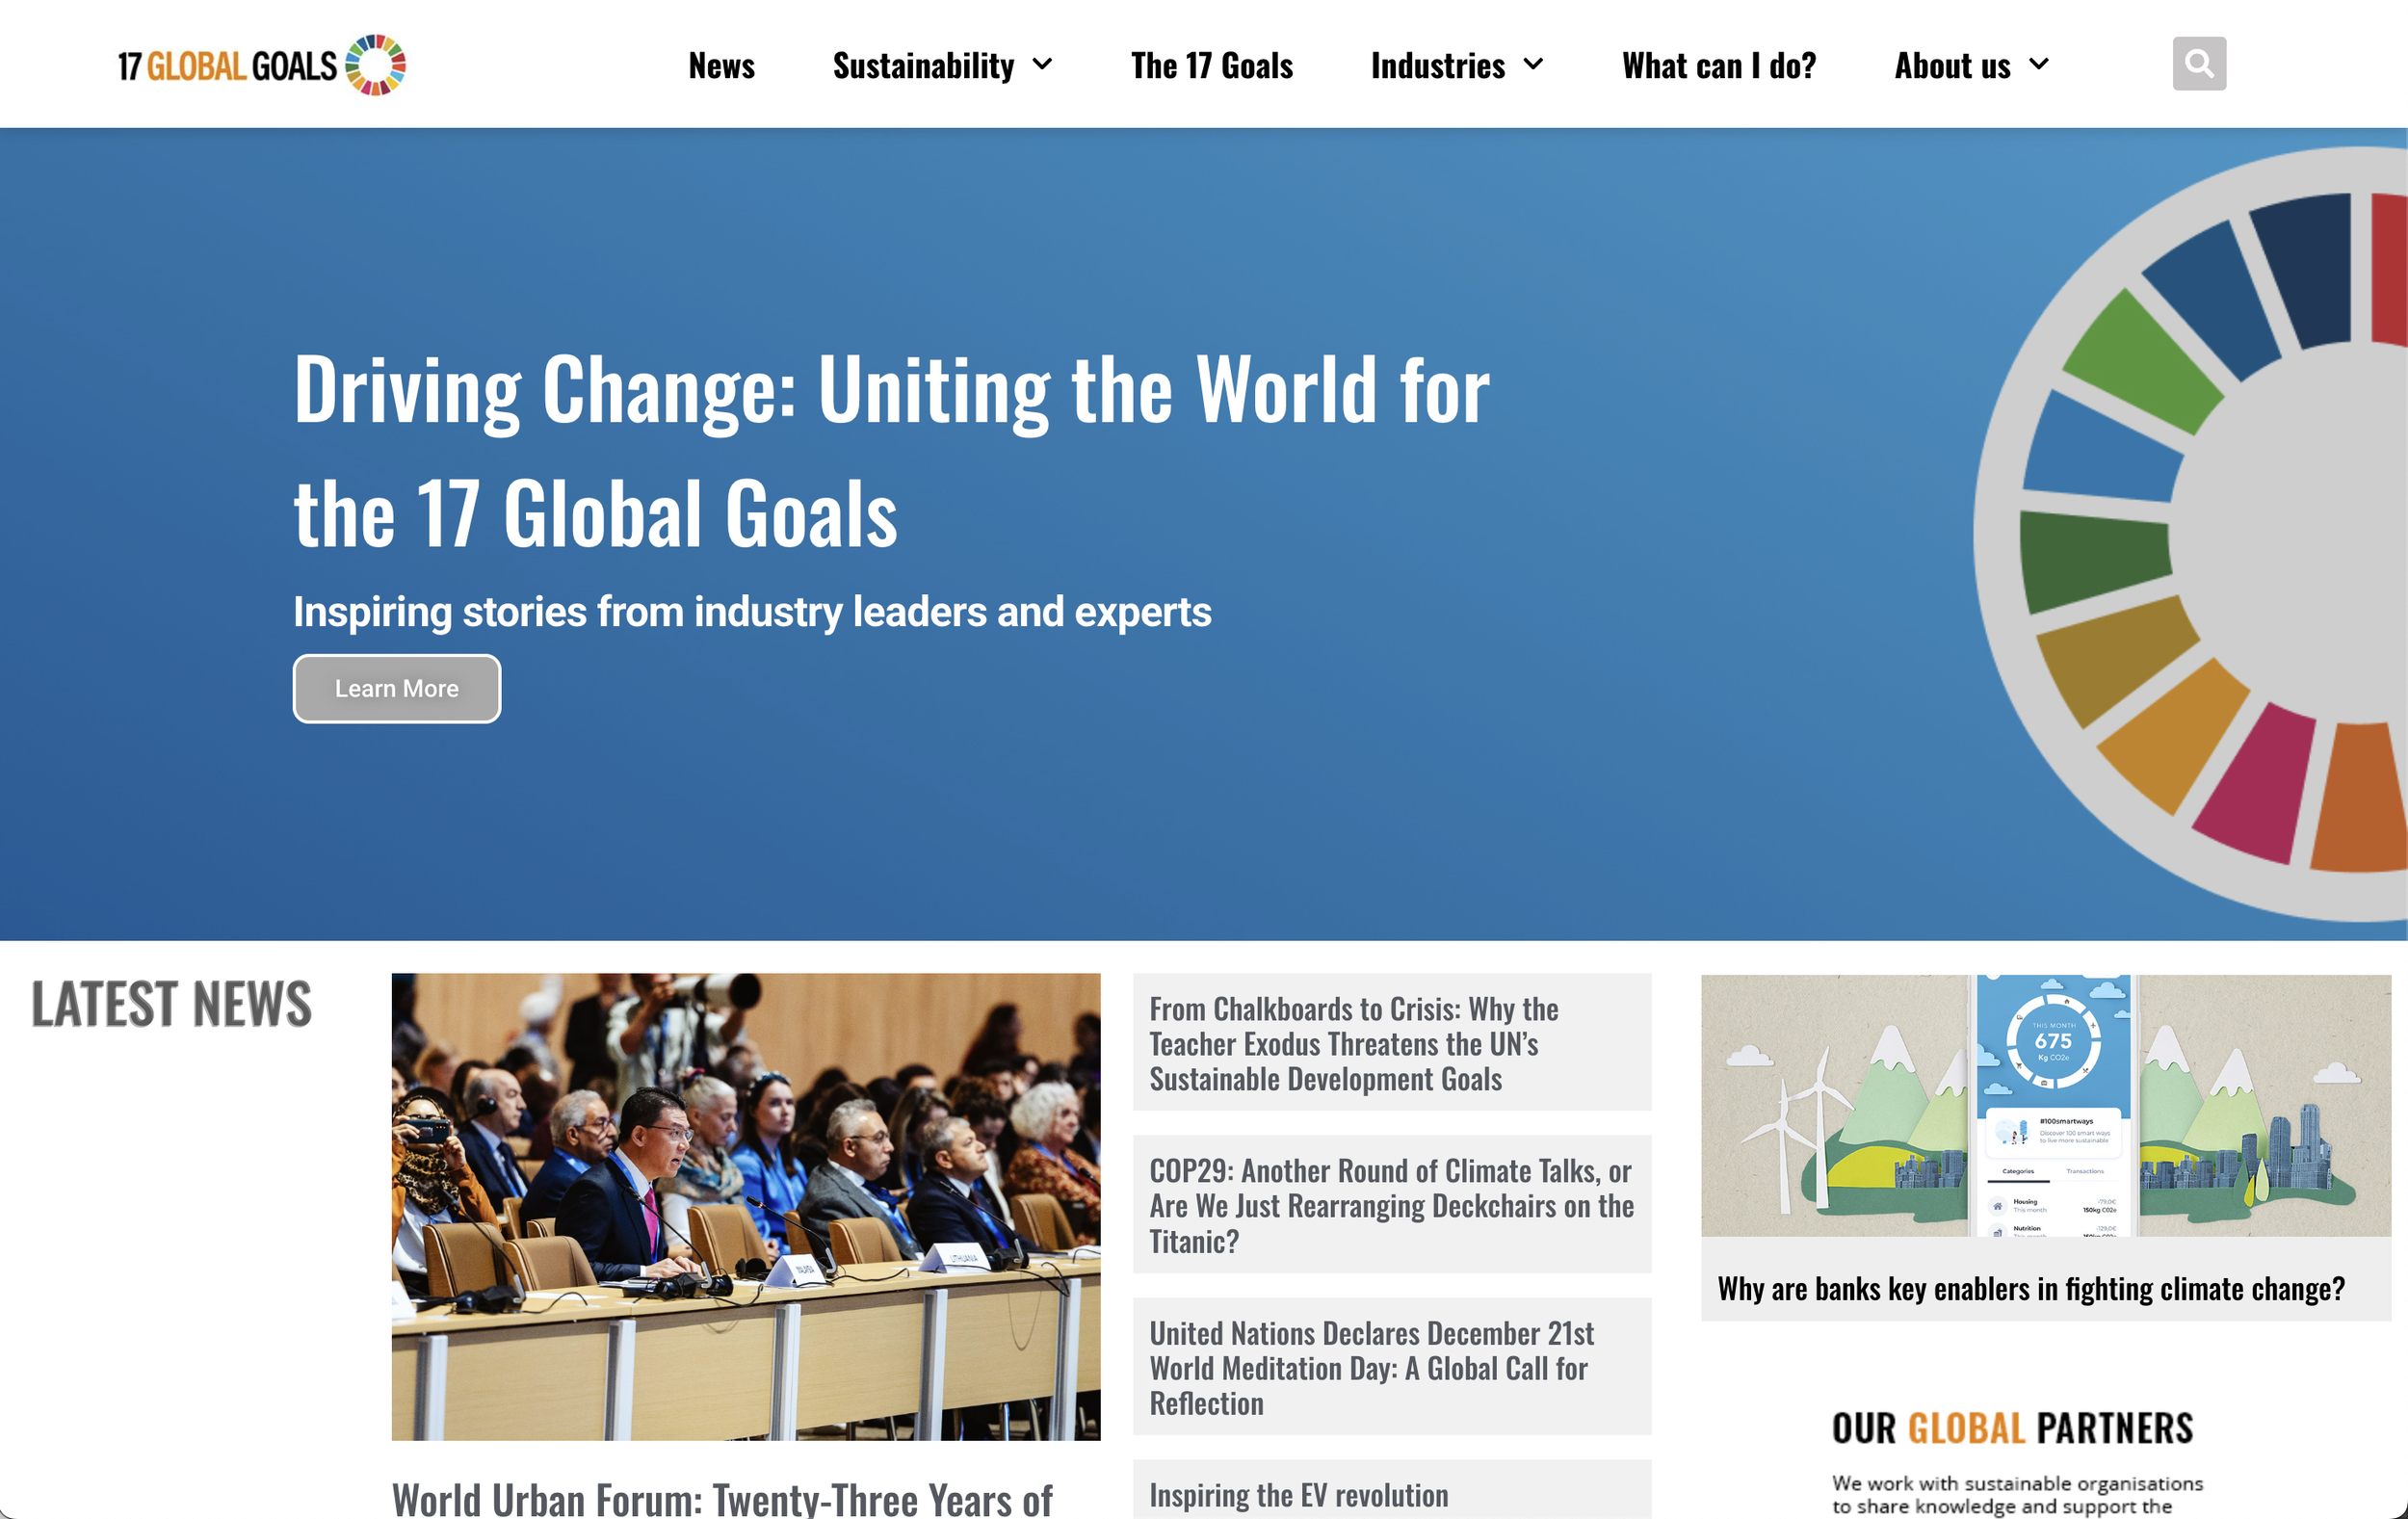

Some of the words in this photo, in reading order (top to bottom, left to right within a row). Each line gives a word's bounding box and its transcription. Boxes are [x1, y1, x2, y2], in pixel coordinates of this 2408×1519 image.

[118, 52, 142, 80] 17
[147, 51, 248, 81] GLOBAL
[252, 51, 337, 81] GOALS
[690, 52, 755, 79] News
[834, 51, 1014, 84] Sustainability
[1132, 52, 1177, 79] The
[1187, 52, 1212, 78] 17
[1222, 51, 1293, 79] Goals
[1373, 52, 1505, 79] Industries
[1623, 52, 1688, 79] What
[1697, 59, 1741, 79] can
[1753, 52, 1759, 78] I
[1770, 51, 1817, 79] do?
[1896, 52, 1972, 79] About
[1982, 59, 2010, 79] us
[298, 354, 522, 438] Driving
[545, 354, 793, 438] Change:
[822, 354, 1051, 438] Uniting
[1072, 354, 1171, 423] the
[1197, 354, 1374, 423] World
[1400, 357, 1489, 423] for
[294, 480, 393, 547] the
[419, 480, 479, 546] 17
[507, 479, 699, 547] Global
[728, 479, 897, 547] Goals
[296, 595, 451, 635] Inspiring
[463, 595, 587, 626] stories
[597, 594, 683, 626] from
[696, 594, 843, 635] industry
[855, 594, 986, 626] leaders
[998, 594, 1063, 626] and
[1076, 598, 1212, 635] experts
[336, 679, 395, 697] Learn
[405, 679, 458, 697] More
[33, 980, 178, 1028] LATEST
[195, 980, 311, 1027] NEWS
[1151, 997, 1205, 1021] From
[1215, 996, 1352, 1021] Chalkboards
[1360, 998, 1382, 1021] to
[1391, 996, 1460, 1021] Crisis:
[1469, 997, 1515, 1023] Why
[1523, 997, 1558, 1021] the
[1150, 1032, 1236, 1056] Teacher
[1245, 1032, 1321, 1056] Exodus
[1328, 1032, 1438, 1056] Threatens
[1446, 1032, 1481, 1056] the
[1491, 1032, 1538, 1056] UN’s
[2034, 1033, 2073, 1050] 675
[2038, 1054, 2049, 1063] Kg
[1151, 1066, 1279, 1090] Sustainable
[1289, 1066, 1433, 1096] Development
[1442, 1066, 1502, 1090] Goals
[1151, 1158, 1233, 1183] COP29:
[1242, 1159, 1330, 1183] Another
[1340, 1159, 1407, 1183] Round
[1417, 1159, 1438, 1183] of
[1447, 1158, 1531, 1183] Climate
[1539, 1159, 1600, 1187] Talks,
[1610, 1165, 1632, 1183] or
[2002, 1167, 2035, 1176] Categories
[1150, 1193, 1187, 1218] Are
[1196, 1193, 1227, 1218] We
[1236, 1193, 1280, 1218] Just
[1289, 1193, 1426, 1223] Rearranging
[1433, 1193, 1556, 1218] Deckchairs
[1565, 1200, 1590, 1218] on
[1598, 1193, 1634, 1218] the
[2013, 1198, 2038, 1207] Housing
[1150, 1229, 1239, 1253] Titanic?
[1718, 1276, 1765, 1305] Why
[1772, 1283, 1807, 1300] are
[1817, 1276, 1880, 1300] banks
[1890, 1276, 1926, 1305] key
[1935, 1276, 2029, 1300] enablers
[2039, 1277, 2057, 1300] in
[2066, 1276, 2154, 1306] fighting
[2161, 1276, 2243, 1300] climate
[2253, 1276, 2345, 1306] change?
[1151, 1321, 1222, 1346] United
[1232, 1321, 1315, 1346] Nations
[1324, 1321, 1420, 1346] Declares
[1428, 1321, 1540, 1346] December
[1549, 1321, 1594, 1346] 21st
[1150, 1356, 1214, 1380] World
[1223, 1356, 1341, 1380] Meditation
[1351, 1356, 1397, 1384] Day:
[1405, 1356, 1420, 1380] A
[1428, 1355, 1497, 1380] Global
[1506, 1355, 1547, 1380] Call
[1557, 1357, 1588, 1380] for
[1151, 1391, 1263, 1415] Reflection
[1833, 1412, 1896, 1444] OUR
[1909, 1412, 2026, 1444] GLOBAL
[2038, 1412, 2193, 1444] PARTNERS
[1151, 1482, 1250, 1512] Inspiring
[1257, 1482, 1293, 1507] the
[1302, 1482, 1327, 1506] EV
[1337, 1482, 1448, 1507] revolution
[1833, 1476, 1862, 1491] We
[1868, 1476, 1913, 1491] work
[1920, 1476, 1958, 1491] with
[1966, 1476, 2071, 1491] sustainable
[2079, 1478, 2203, 1496] organisations
[393, 1483, 480, 1517] World
[494, 1483, 584, 1517] Urban
[598, 1483, 701, 1517] Forum:
[713, 1483, 917, 1519] Twenty-Three
[929, 1483, 1011, 1517] Years
[1024, 1484, 1053, 1517] of
[1833, 1502, 1851, 1513] to
[1858, 1499, 1909, 1513] share
[1917, 1498, 2016, 1518] knowledge
[2023, 1498, 2056, 1513] and
[2063, 1503, 2136, 1518] support
[2142, 1499, 2172, 1513] the
